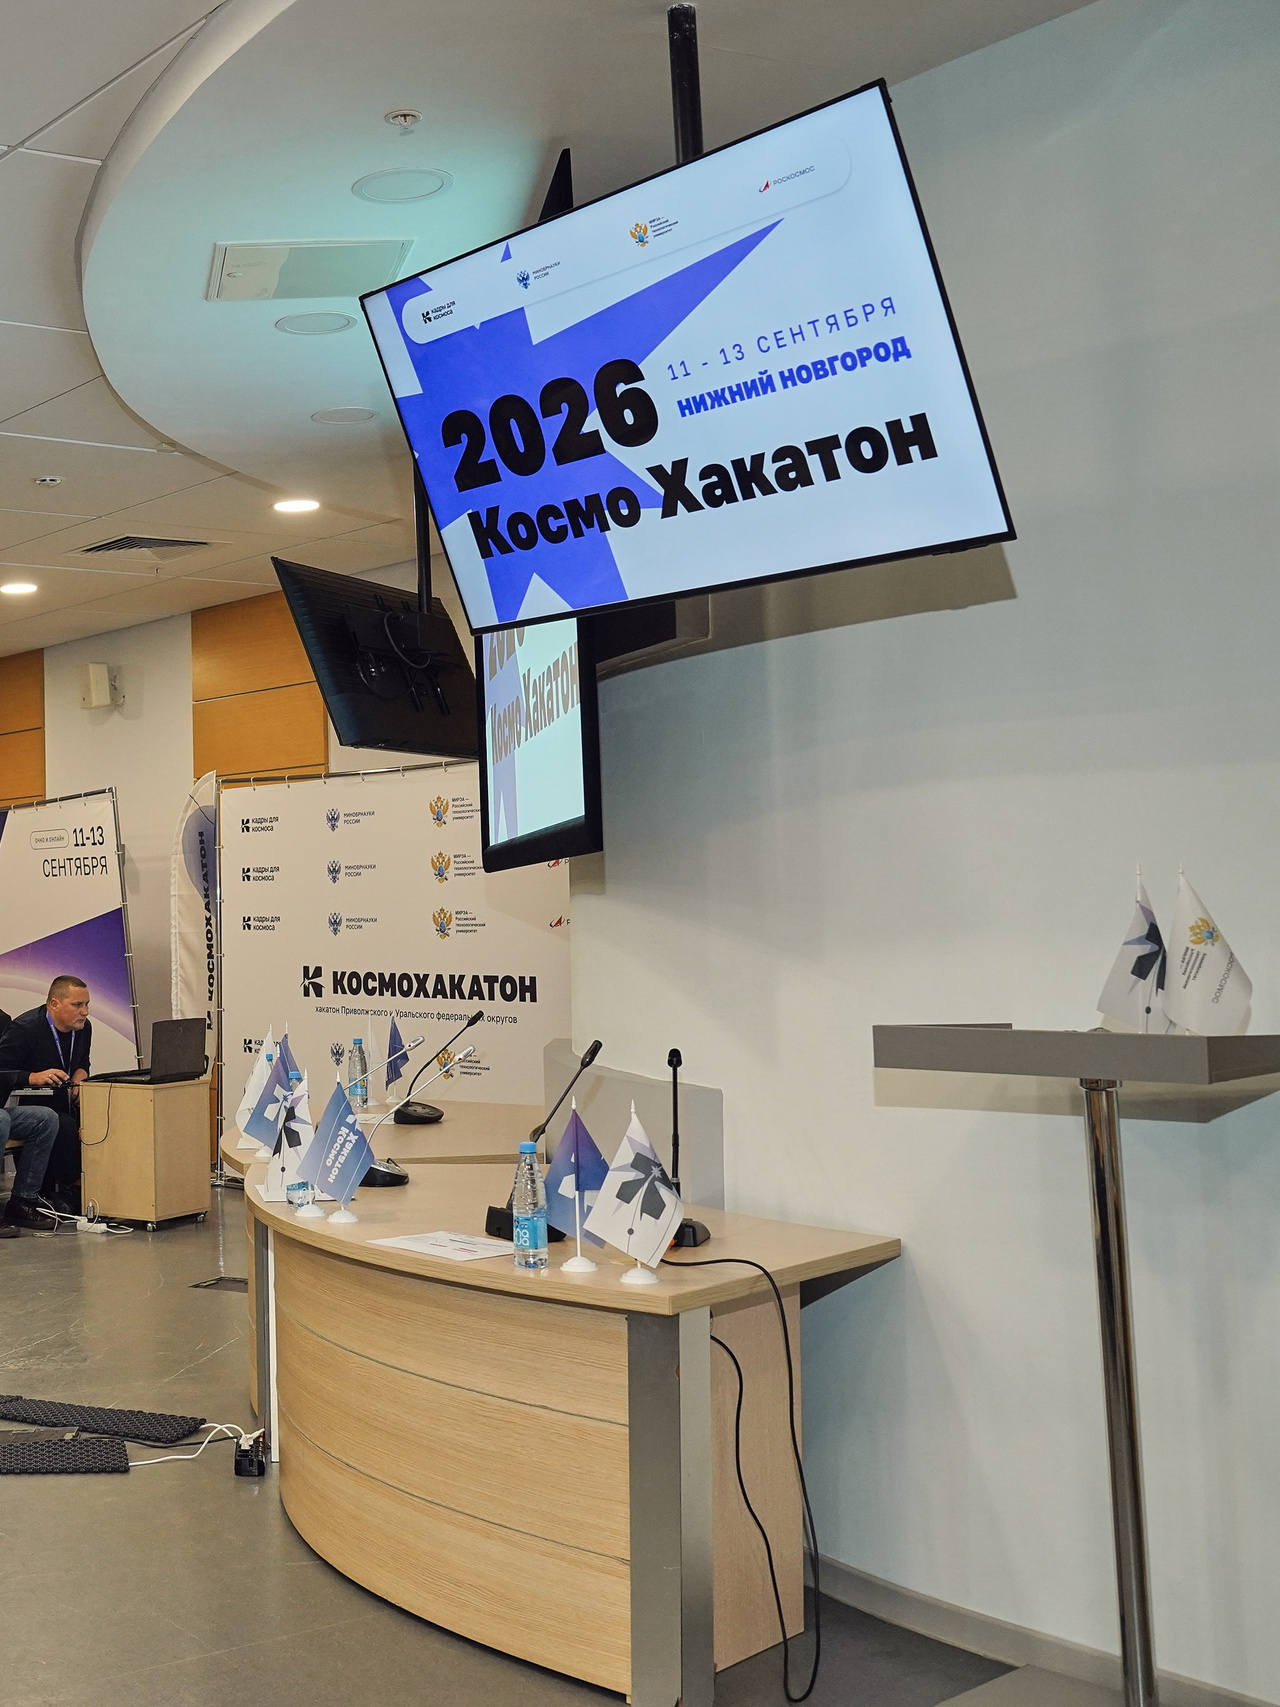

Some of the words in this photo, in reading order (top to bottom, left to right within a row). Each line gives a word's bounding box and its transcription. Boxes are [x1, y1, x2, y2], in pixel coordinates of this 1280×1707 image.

[772, 166, 816, 186] РОСКОСМОС
[534, 272, 550, 280] РОССИИ
[433, 309, 454, 320] космоса
[667, 360, 691, 381] 11
[719, 343, 745, 366] 13
[756, 296, 896, 354] СЕНТЯБРЯ
[676, 369, 776, 418] НИЖНИЙ
[778, 336, 912, 390] НОВГОРОД
[440, 358, 659, 493] 2026
[467, 485, 642, 560] Космо
[645, 411, 939, 520] Хакатон
[490, 695, 522, 766] Космо
[522, 640, 580, 742] Хакатон
[252, 817, 268, 825] кадры
[72, 826, 104, 847] 11-13
[42, 856, 108, 878] СЕНТЯБРЯ
[252, 866, 269, 874] кадры
[198, 831, 216, 1001] КОСМОХАКАТОН
[253, 916, 270, 924] кадры
[332, 970, 538, 1002] КОСМОХАКАТОН
[314, 1006, 340, 1014] хакатон
[341, 1006, 388, 1016] Приволжского
[395, 1009, 434, 1019] Уральского
[436, 1012, 485, 1022] федеральх
[486, 1015, 518, 1025] округов
